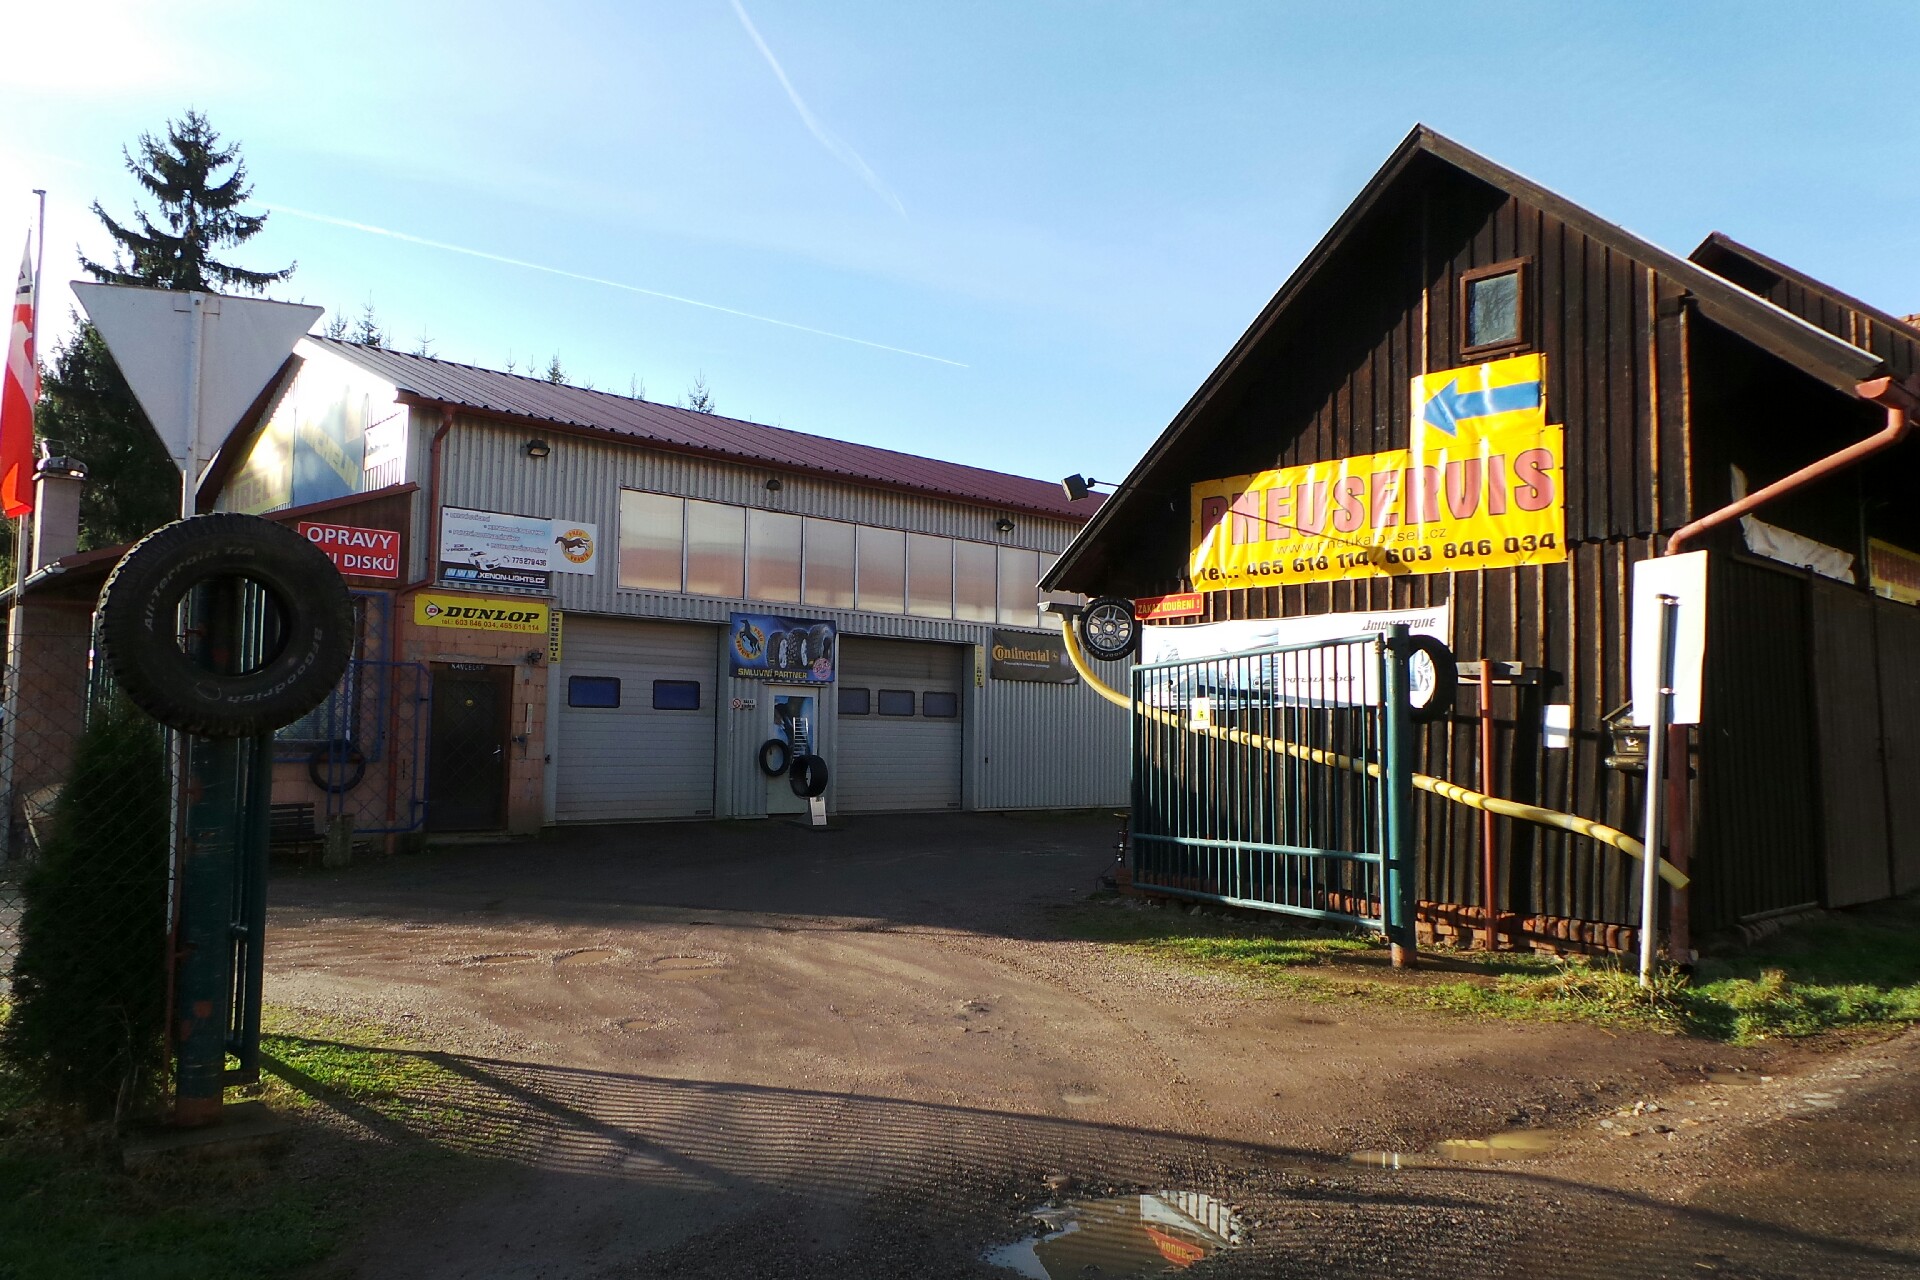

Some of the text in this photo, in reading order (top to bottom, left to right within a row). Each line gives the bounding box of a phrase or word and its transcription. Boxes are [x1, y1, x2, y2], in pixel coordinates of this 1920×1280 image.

[1201, 448, 1555, 548] PNEUSERVIS
[307, 526, 393, 549] OPRAVY
[344, 553, 395, 571] DISKŮ
[512, 556, 523, 564] 775
[536, 558, 547, 566] 436
[1247, 560, 1284, 576] 465
[1292, 556, 1329, 572] 618
[1385, 545, 1432, 564] 603
[1443, 539, 1492, 559] 846
[1504, 532, 1556, 553] 034
[444, 606, 540, 622] DUNLOP
[1137, 602, 1161, 614] ZÁKAZ
[1162, 598, 1195, 612] KOUŘENÍ
[455, 618, 468, 626] 603
[469, 619, 482, 627] 846
[992, 644, 1050, 662] Continental
[738, 667, 808, 679] SMLUVNÍ PARTNER
